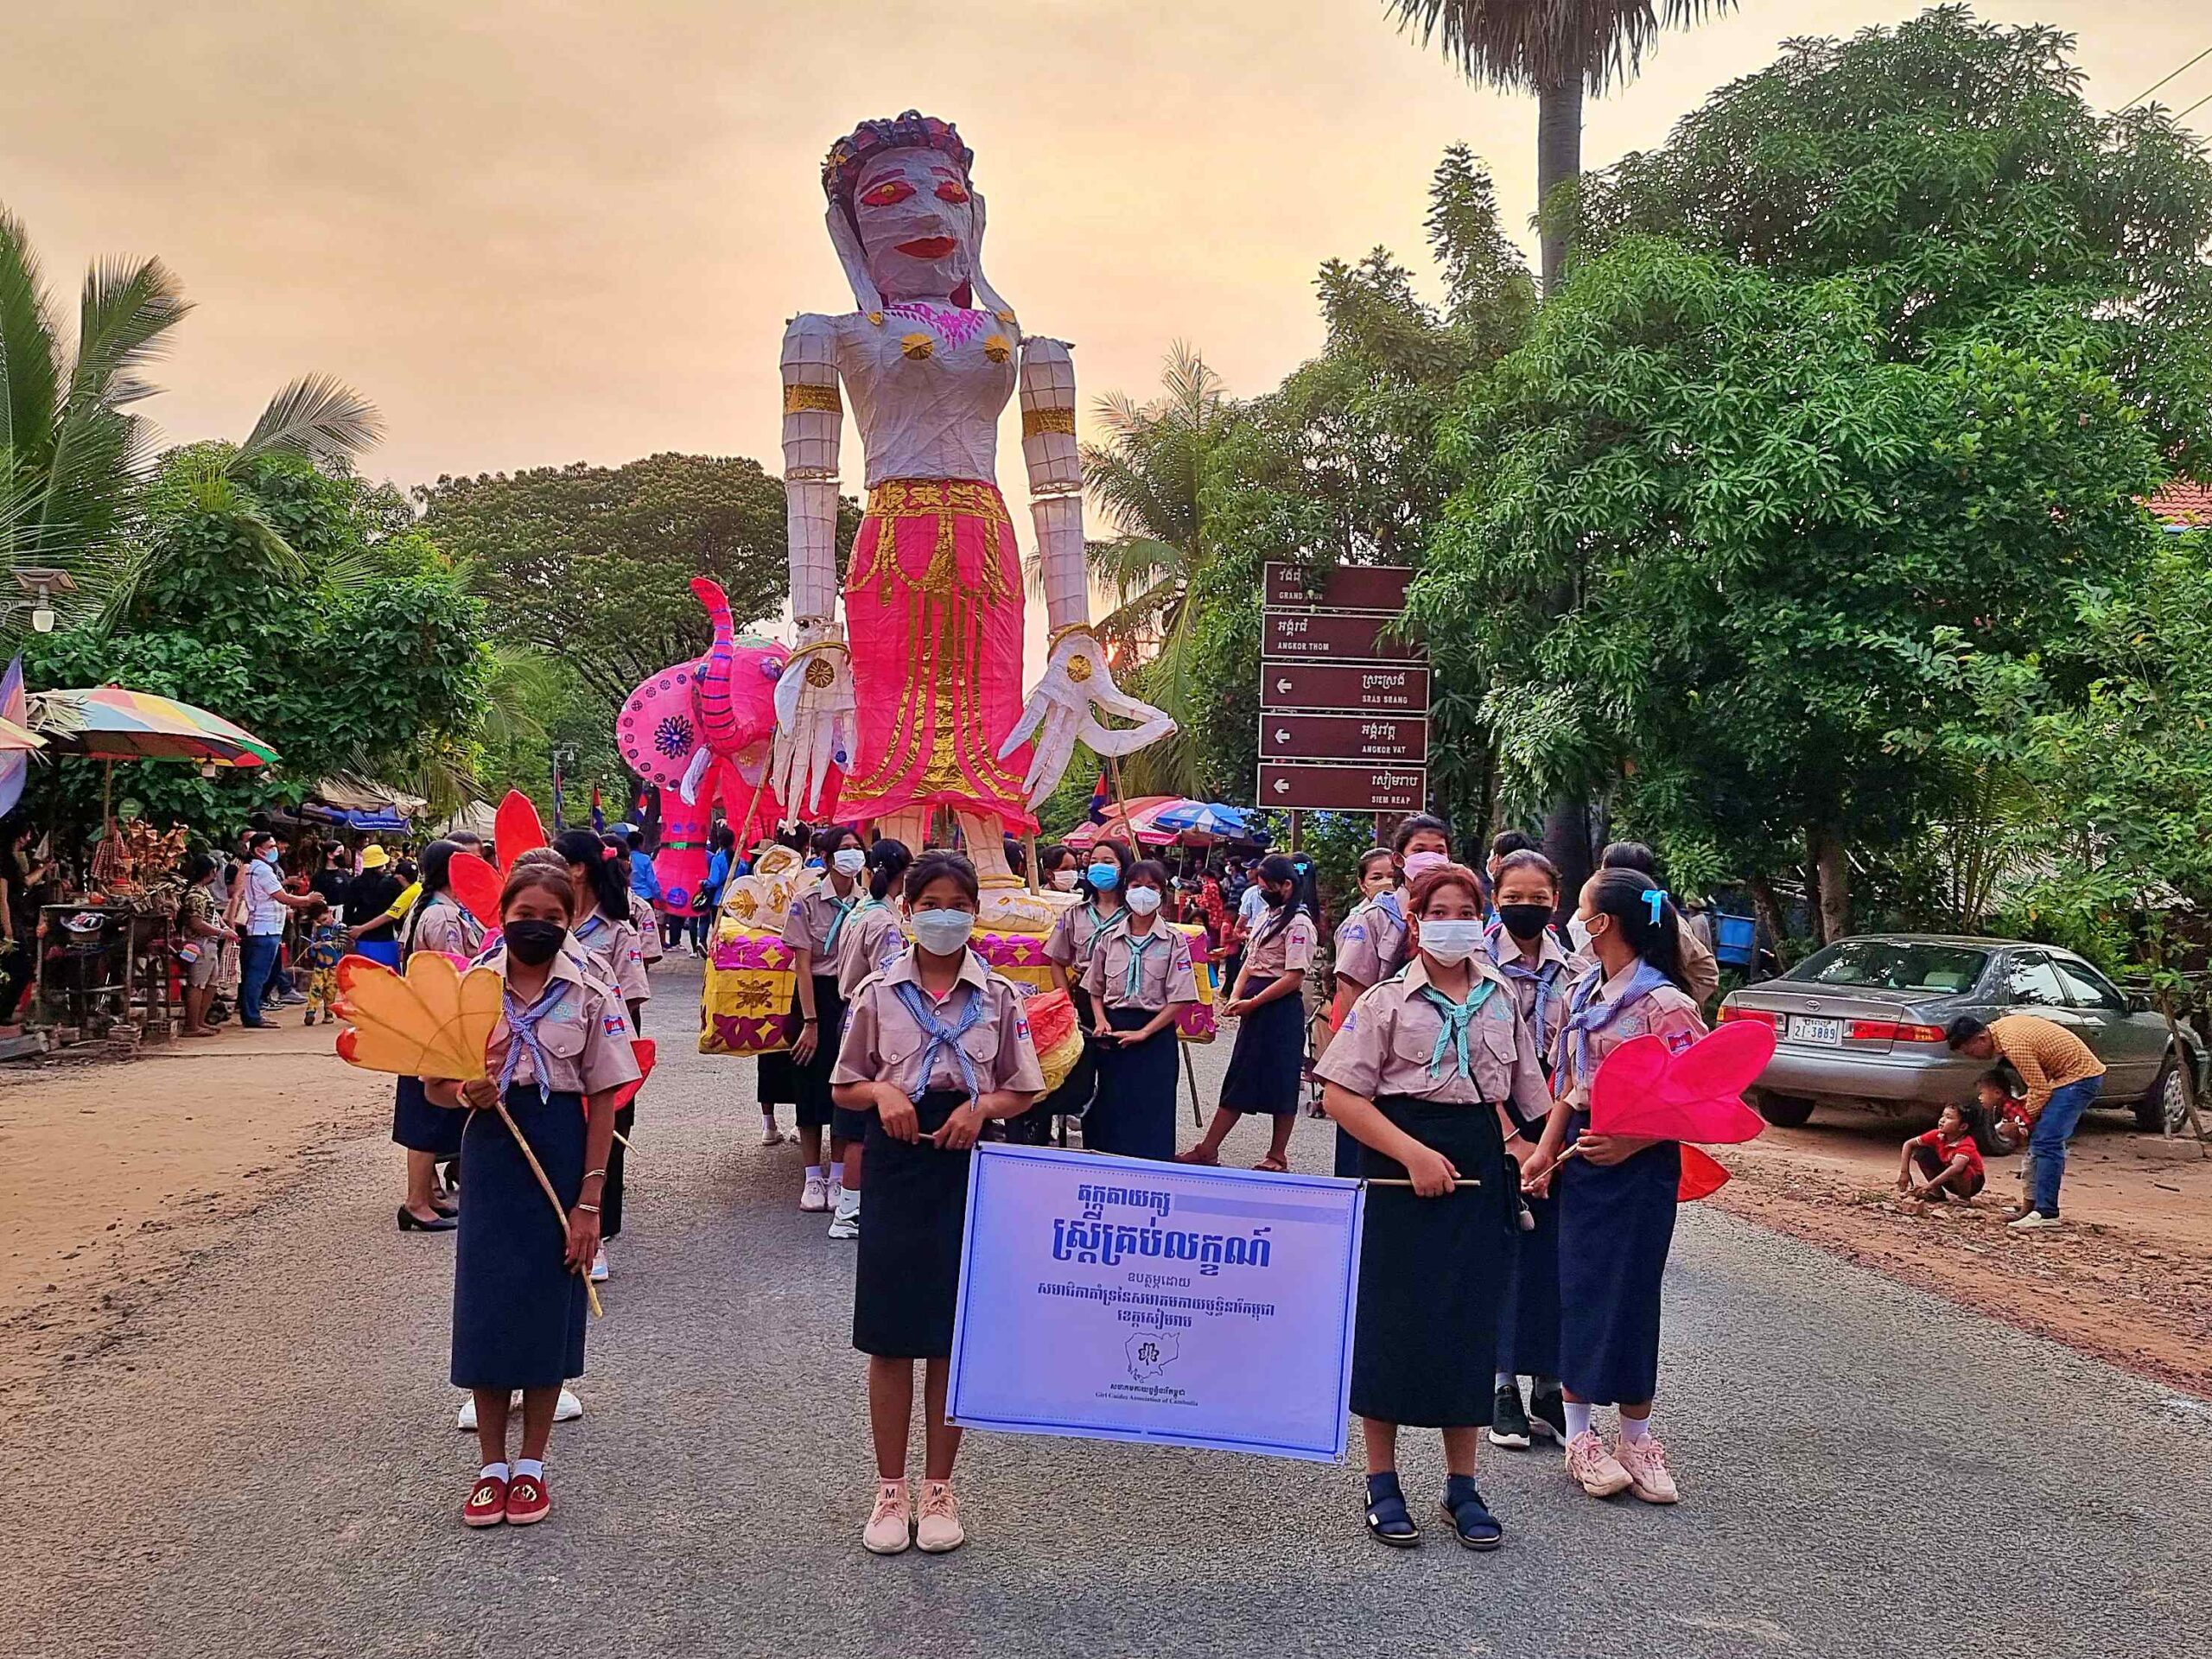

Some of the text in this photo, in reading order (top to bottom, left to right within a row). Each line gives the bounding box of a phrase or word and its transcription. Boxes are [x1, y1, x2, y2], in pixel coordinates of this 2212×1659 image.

[1279, 591, 1303, 601] GRAND
[1277, 618, 1308, 637] អង្គរធំ
[1277, 642, 1330, 652] ANGKOR THOM
[1362, 695, 1408, 704] SRAS SRANG
[1362, 745, 1407, 754] ANGKOR VAT
[1371, 770, 1419, 791] សៀមរាប
[1371, 795, 1411, 805] SIEM REAP
